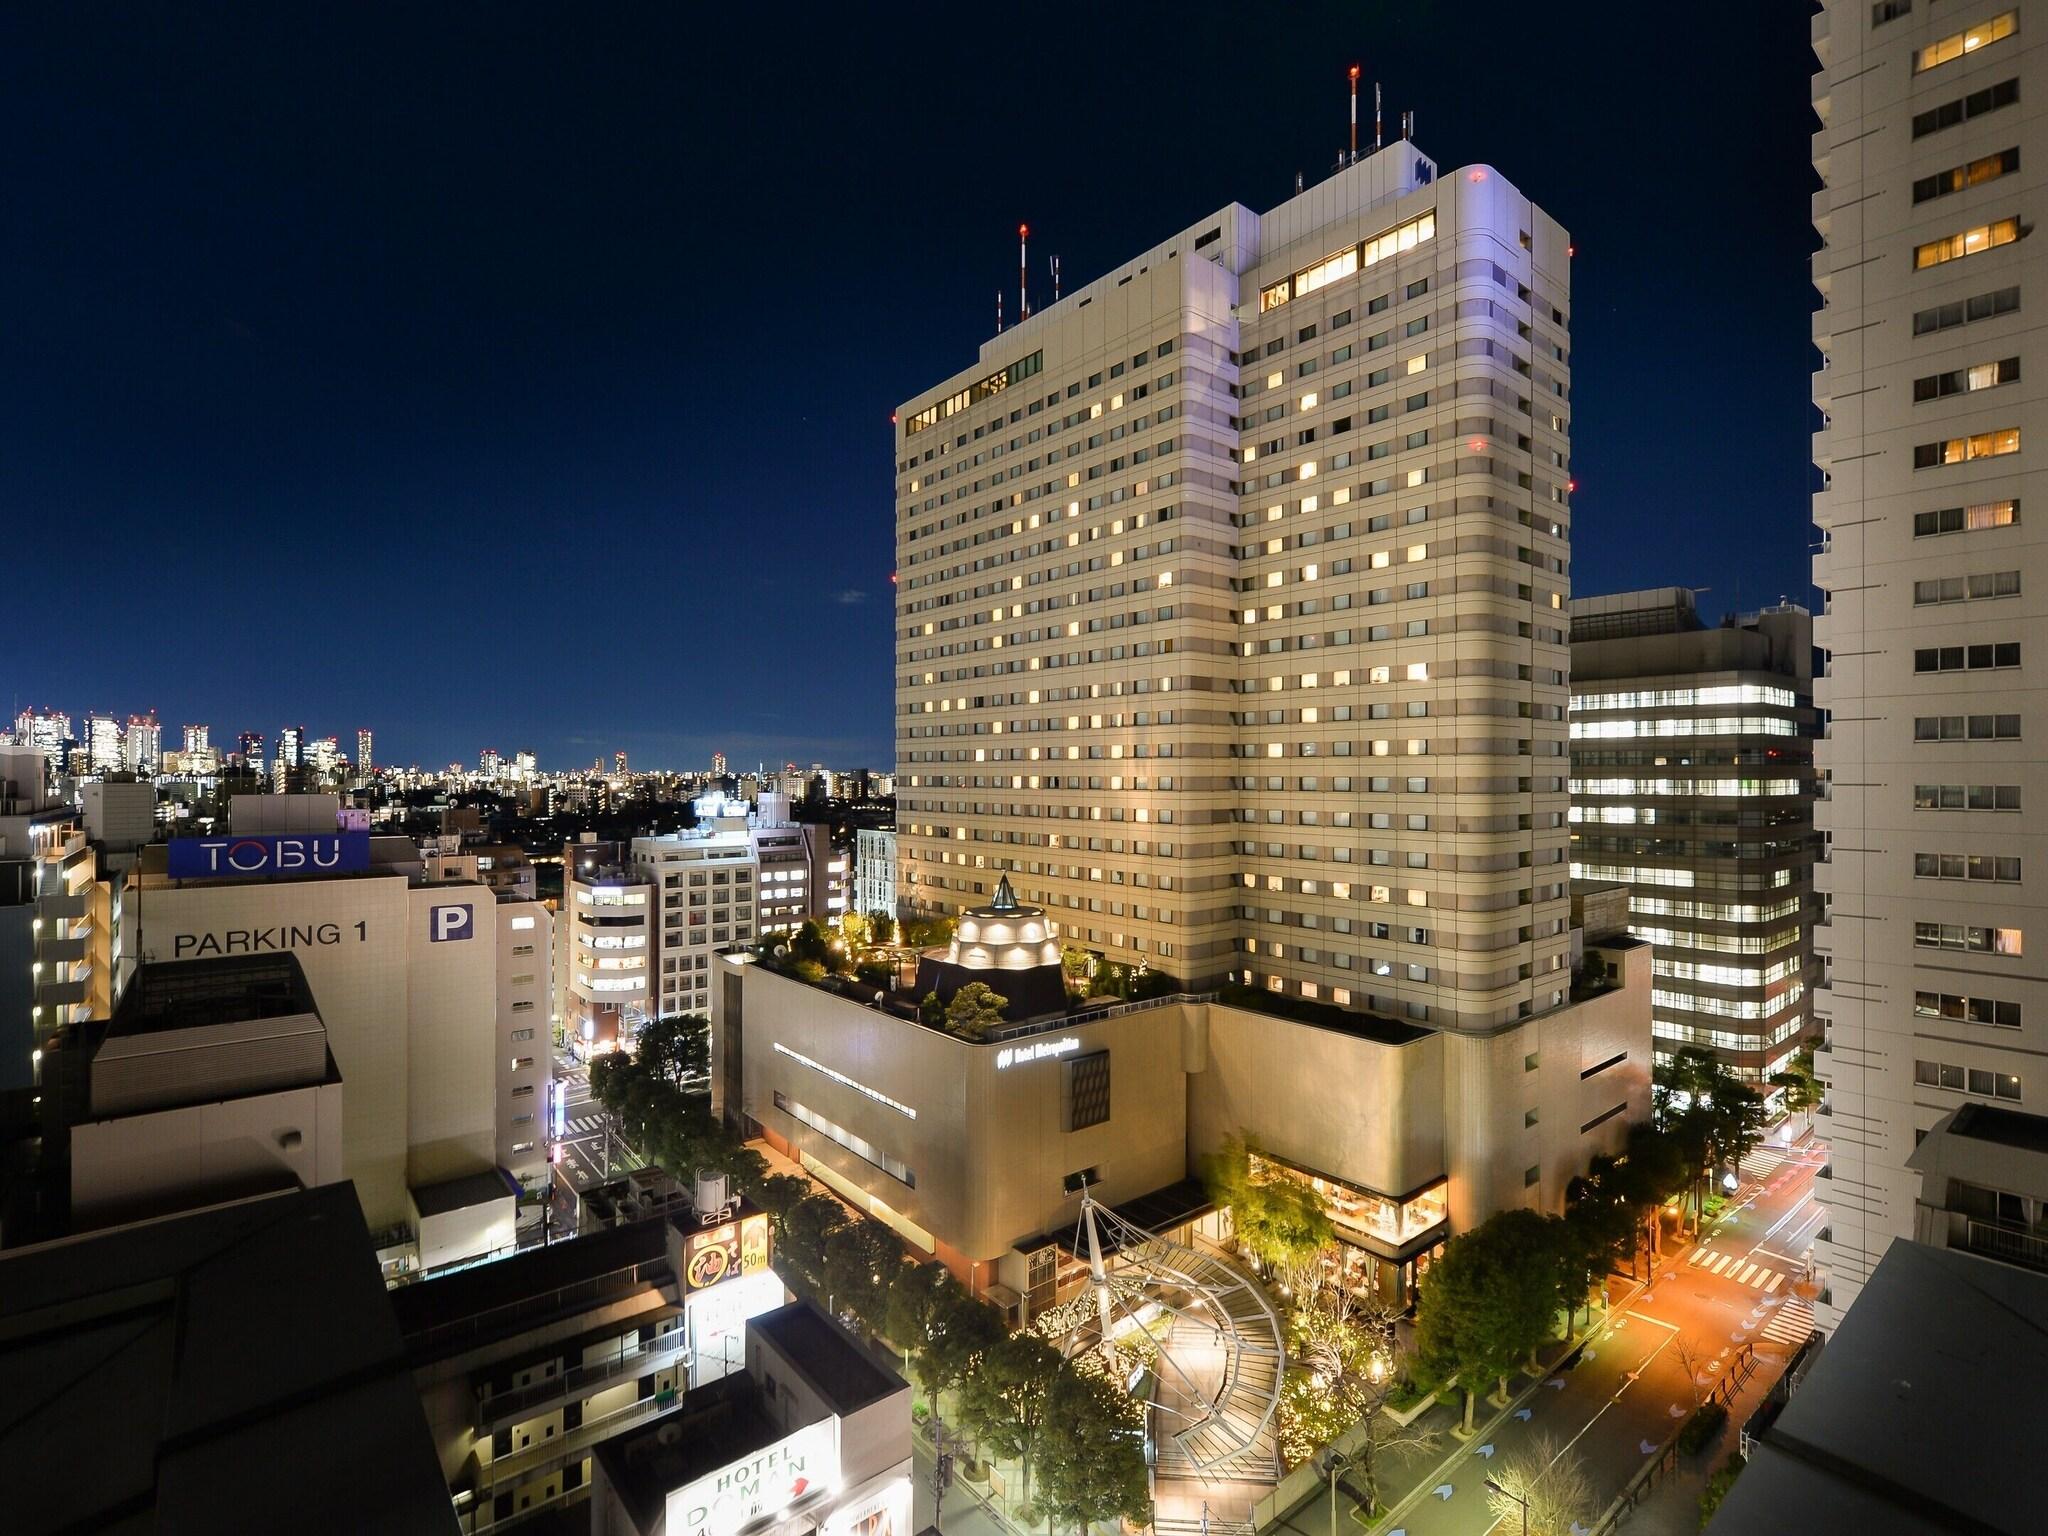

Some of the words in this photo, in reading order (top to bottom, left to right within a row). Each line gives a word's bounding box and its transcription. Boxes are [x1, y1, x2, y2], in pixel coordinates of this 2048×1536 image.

[200, 839, 340, 871] TOBU
[174, 922, 341, 958] PARKING
[354, 920, 367, 942] 1
[438, 906, 469, 941] P
[1014, 1044, 1034, 1063] Hotel
[716, 1446, 793, 1493] HOTEL
